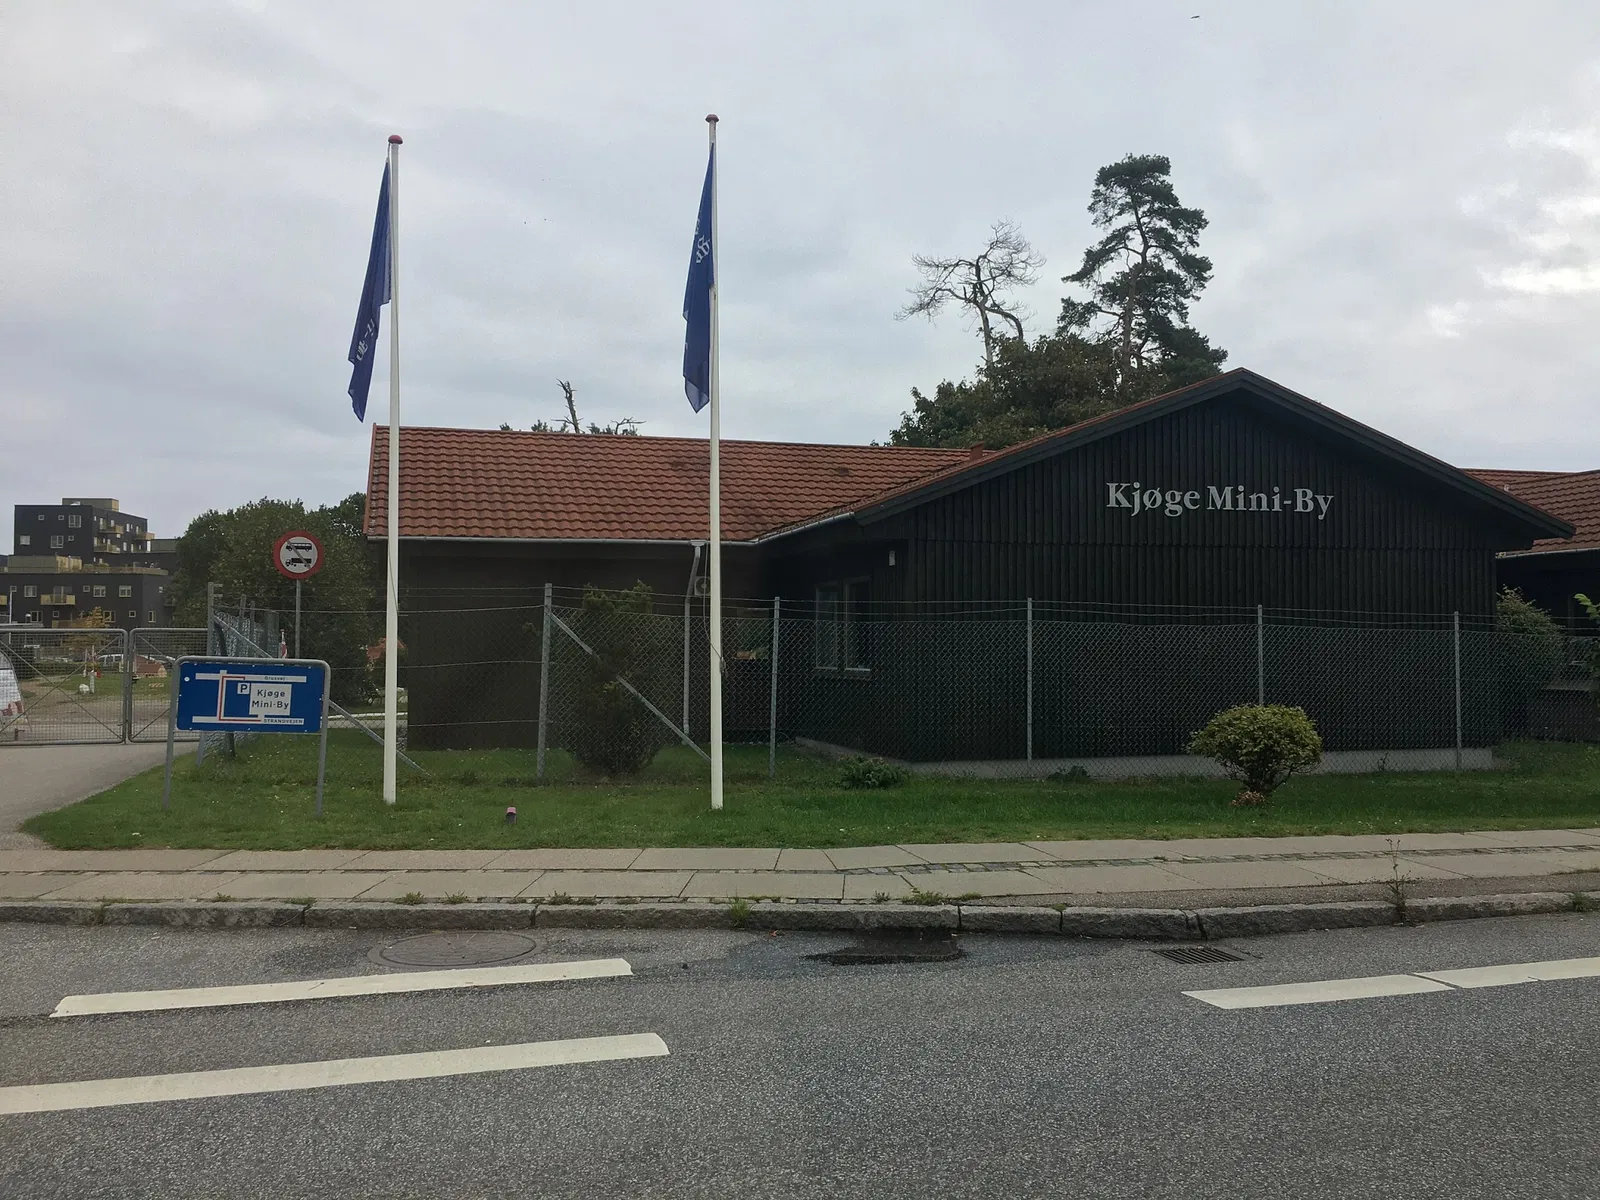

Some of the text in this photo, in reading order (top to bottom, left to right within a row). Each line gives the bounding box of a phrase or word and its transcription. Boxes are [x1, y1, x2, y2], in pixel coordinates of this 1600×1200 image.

[1106, 481, 1334, 520] Kjøge Mini-By
[240, 684, 248, 693] P
[257, 689, 286, 698] Kjøge
[251, 700, 289, 710] Mini-By
